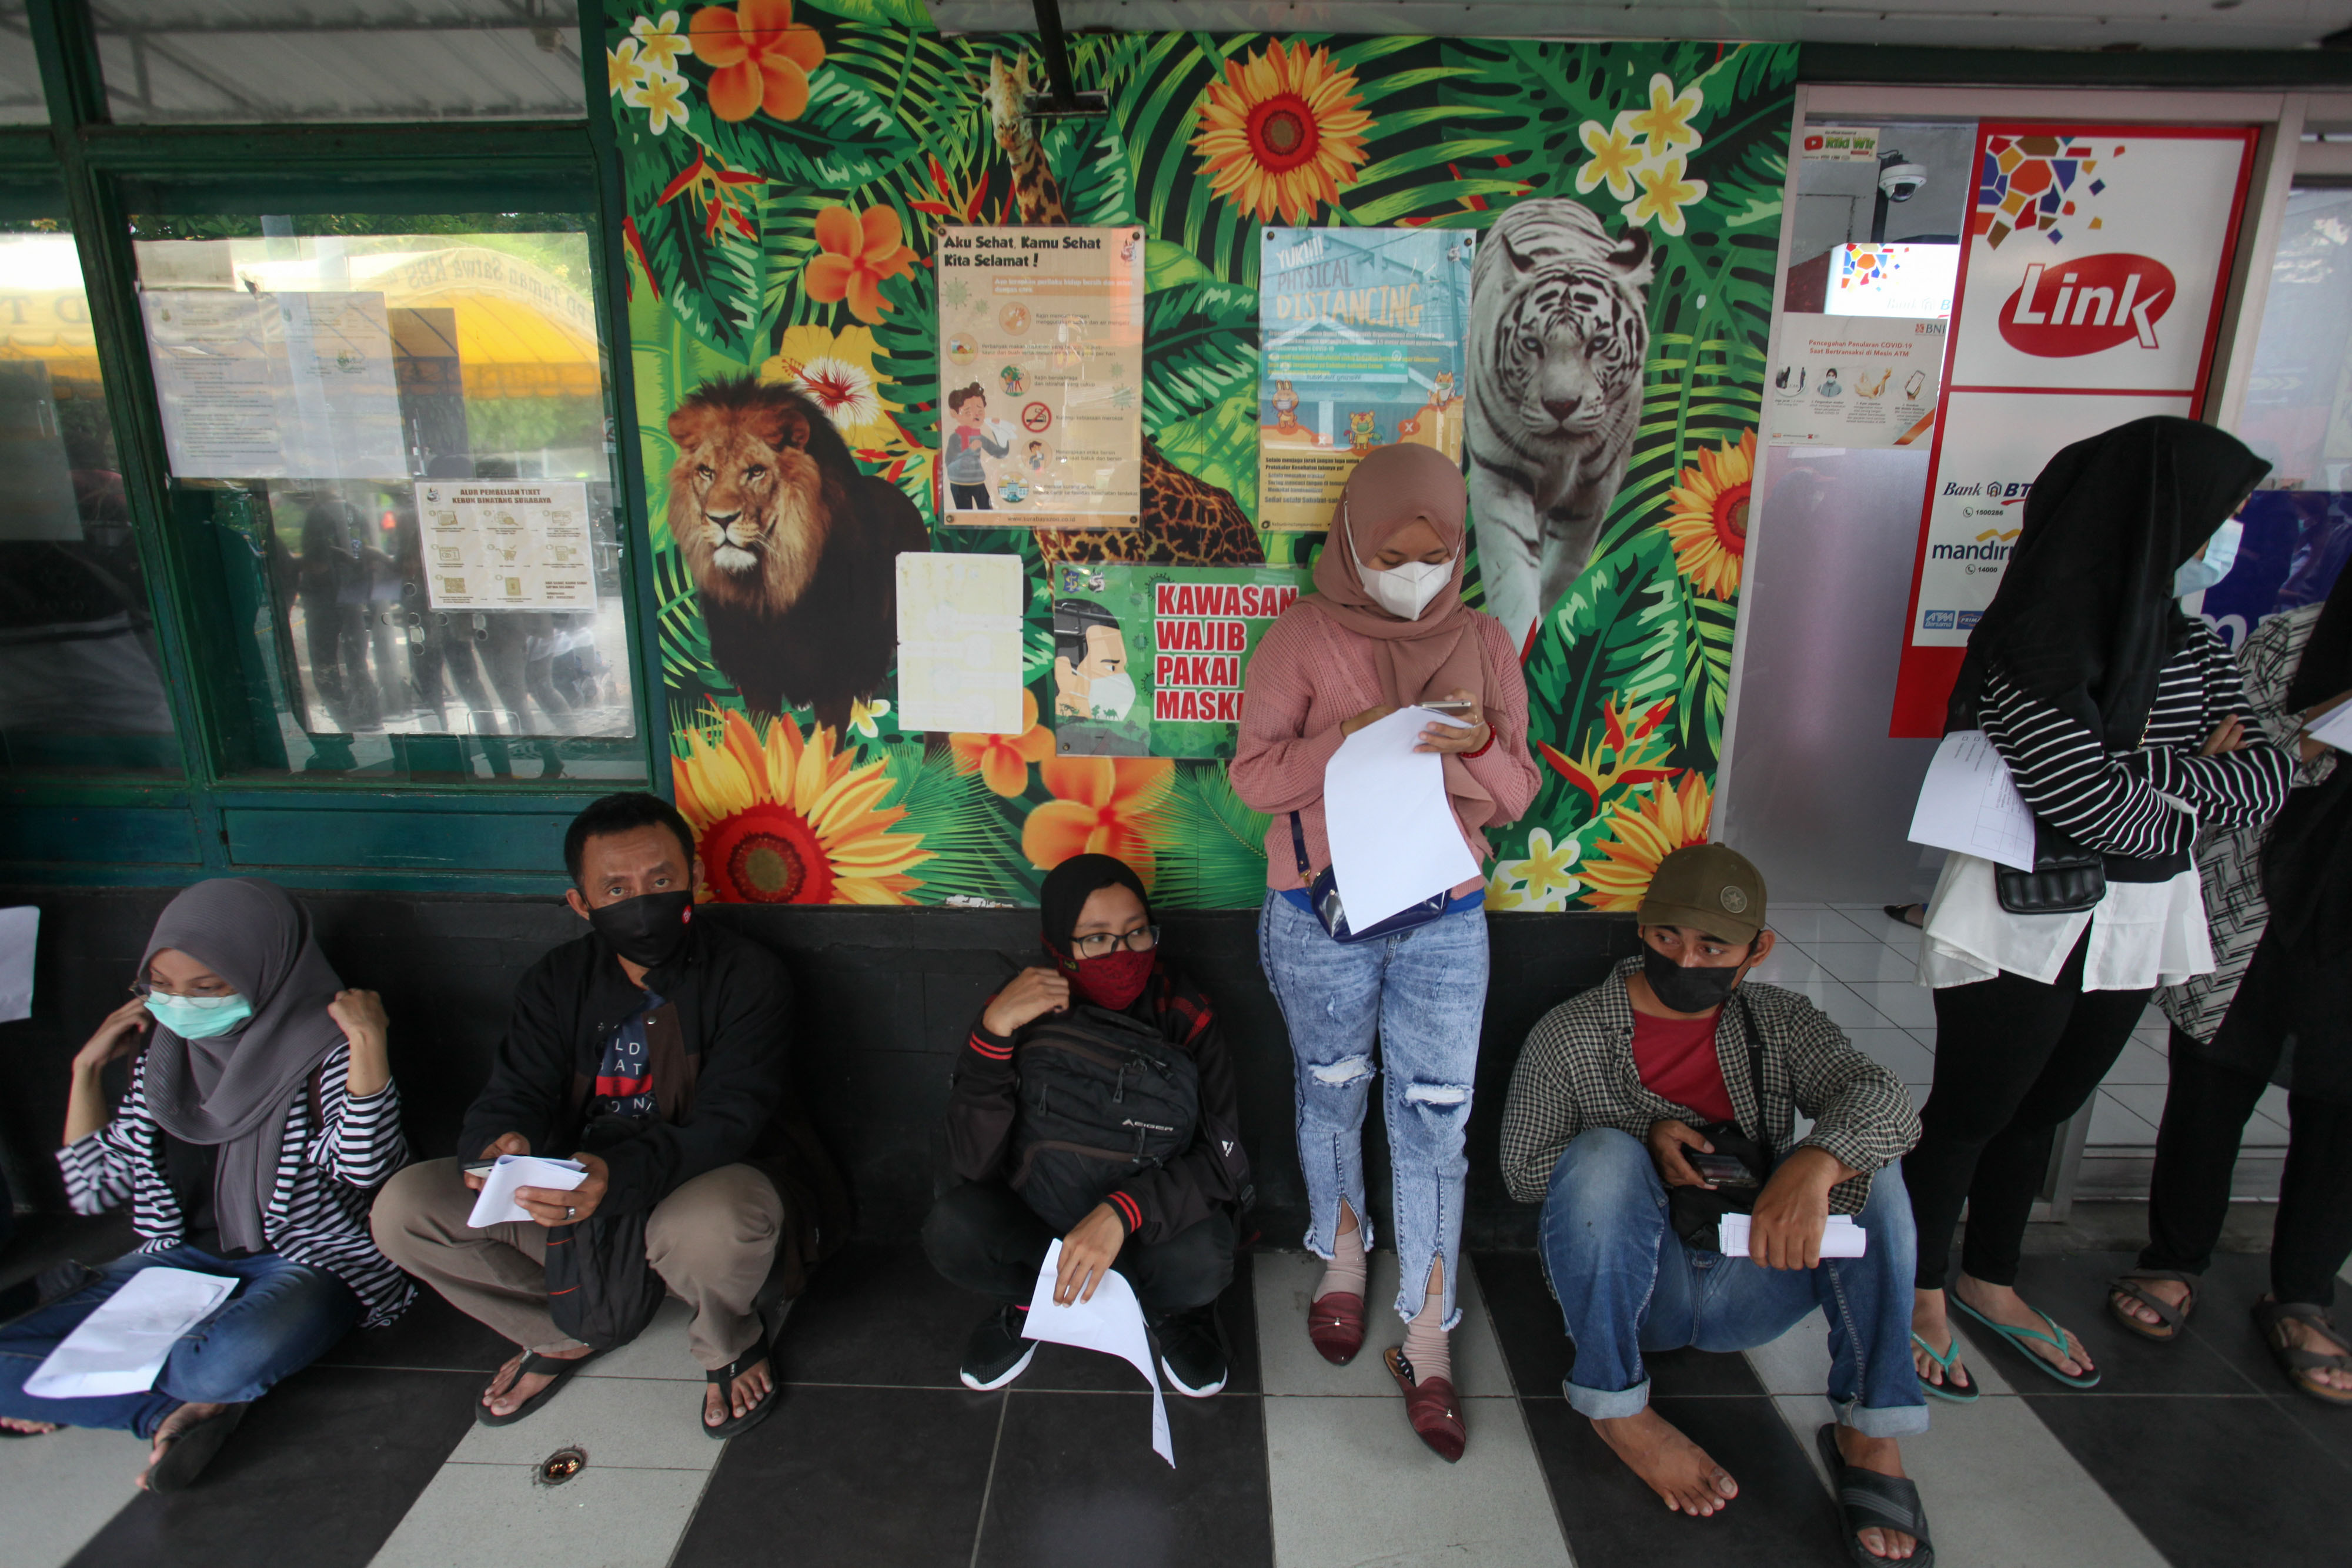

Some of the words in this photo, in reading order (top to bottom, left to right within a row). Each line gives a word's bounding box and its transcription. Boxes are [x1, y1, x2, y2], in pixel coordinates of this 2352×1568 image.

[944, 236, 971, 248] Aku
[975, 236, 1016, 249] Sehat,
[1021, 236, 1058, 249] Kamu
[1063, 236, 1101, 249] Sehat
[944, 254, 970, 266] Kita
[974, 254, 1029, 266] Selamat
[1033, 253, 1038, 266] !
[1278, 259, 1354, 291] PHYSICAL
[1276, 283, 1424, 327] DISTANCING
[1940, 299, 1951, 310] B
[2012, 263, 2166, 349] Link
[1926, 324, 1946, 334] BNI
[1943, 482, 1983, 496] Bank
[2003, 483, 2034, 497] BT
[1157, 584, 1298, 617] KAWASAN
[1926, 613, 1953, 621] ATM
[1155, 620, 1246, 652] WAJIB
[1156, 656, 1239, 687] PAKAI
[1134, 1121, 1174, 1132] EIGER
